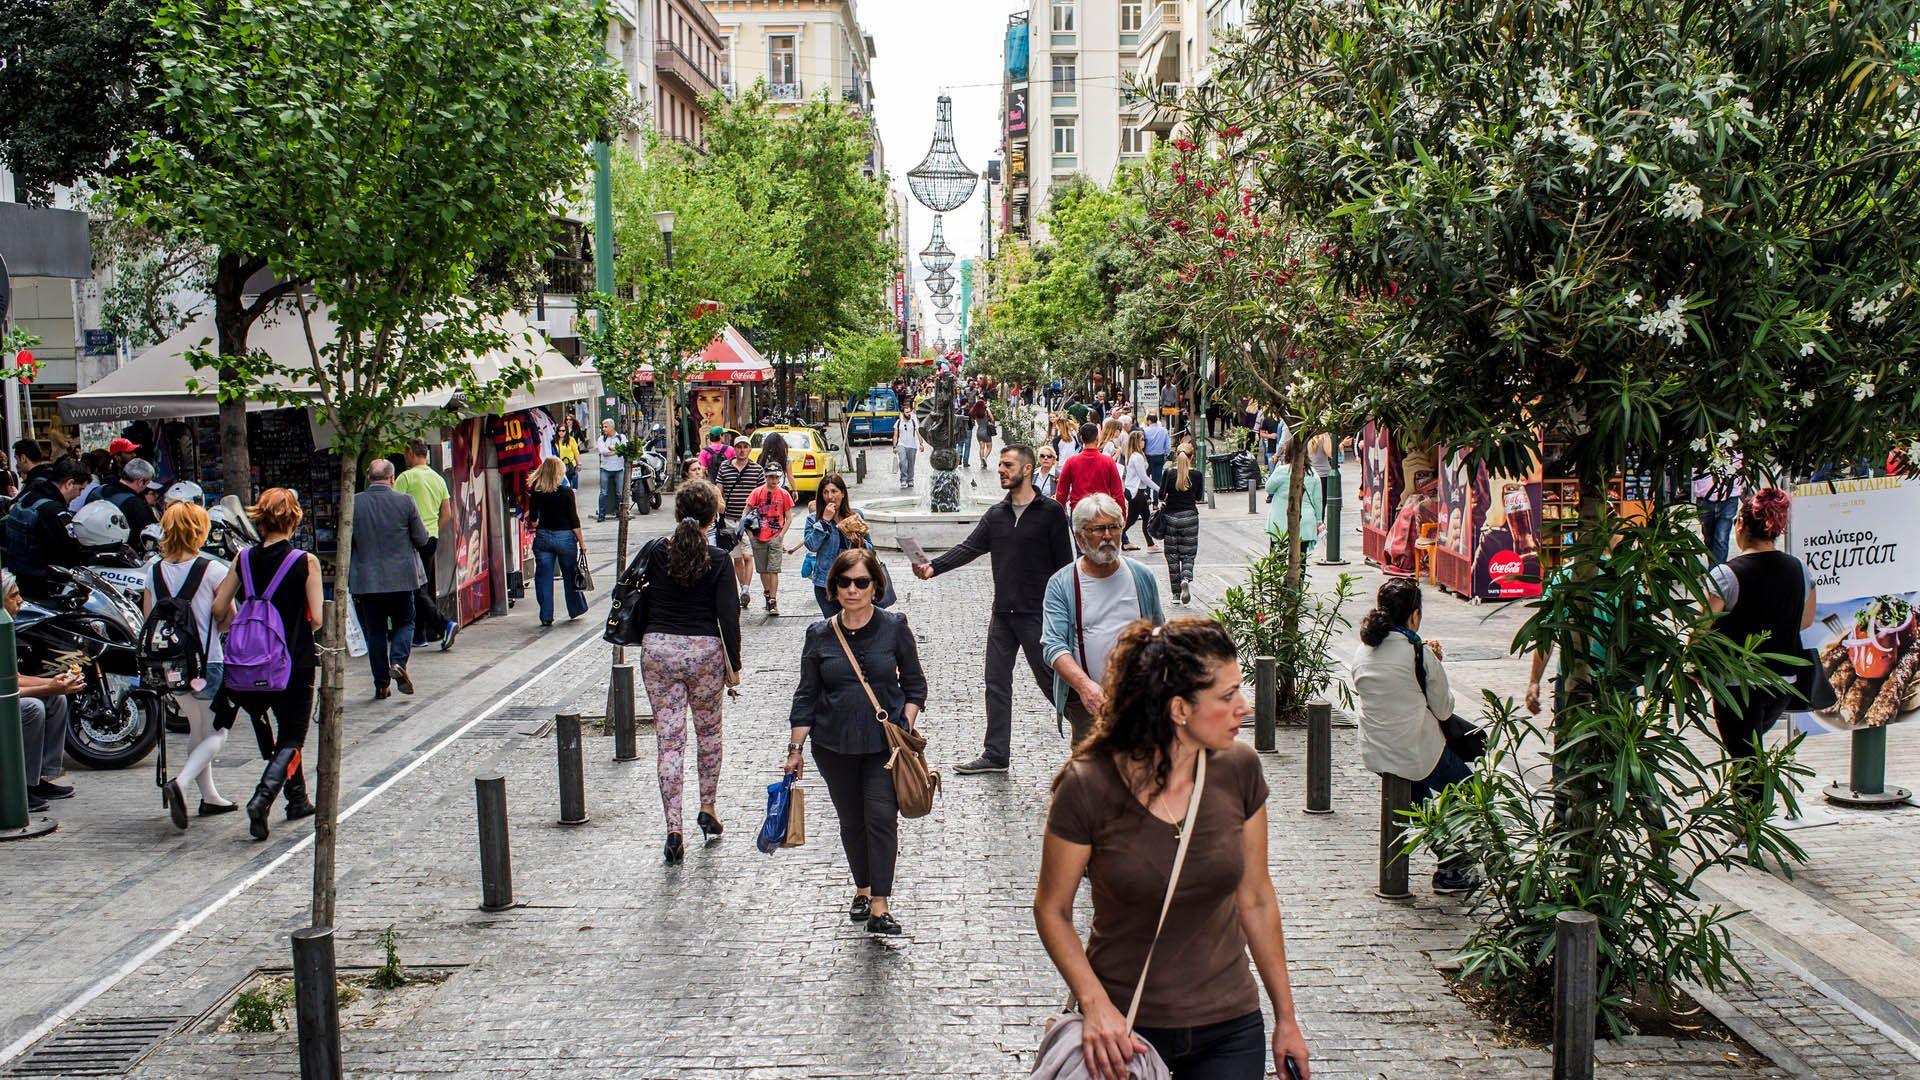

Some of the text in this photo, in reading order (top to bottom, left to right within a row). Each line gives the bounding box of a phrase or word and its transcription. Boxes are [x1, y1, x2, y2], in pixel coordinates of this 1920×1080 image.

[730, 370, 758, 380] Coca-Cola
[70, 403, 156, 418] www.migato.gr
[503, 418, 523, 442] 10
[1810, 529, 1878, 546] καλύτερο,
[1805, 542, 1897, 576] κεμπάπ
[1489, 561, 1521, 574] Coca-Cola
[100, 571, 145, 586] POLICE
[1816, 574, 1840, 586] όλης
